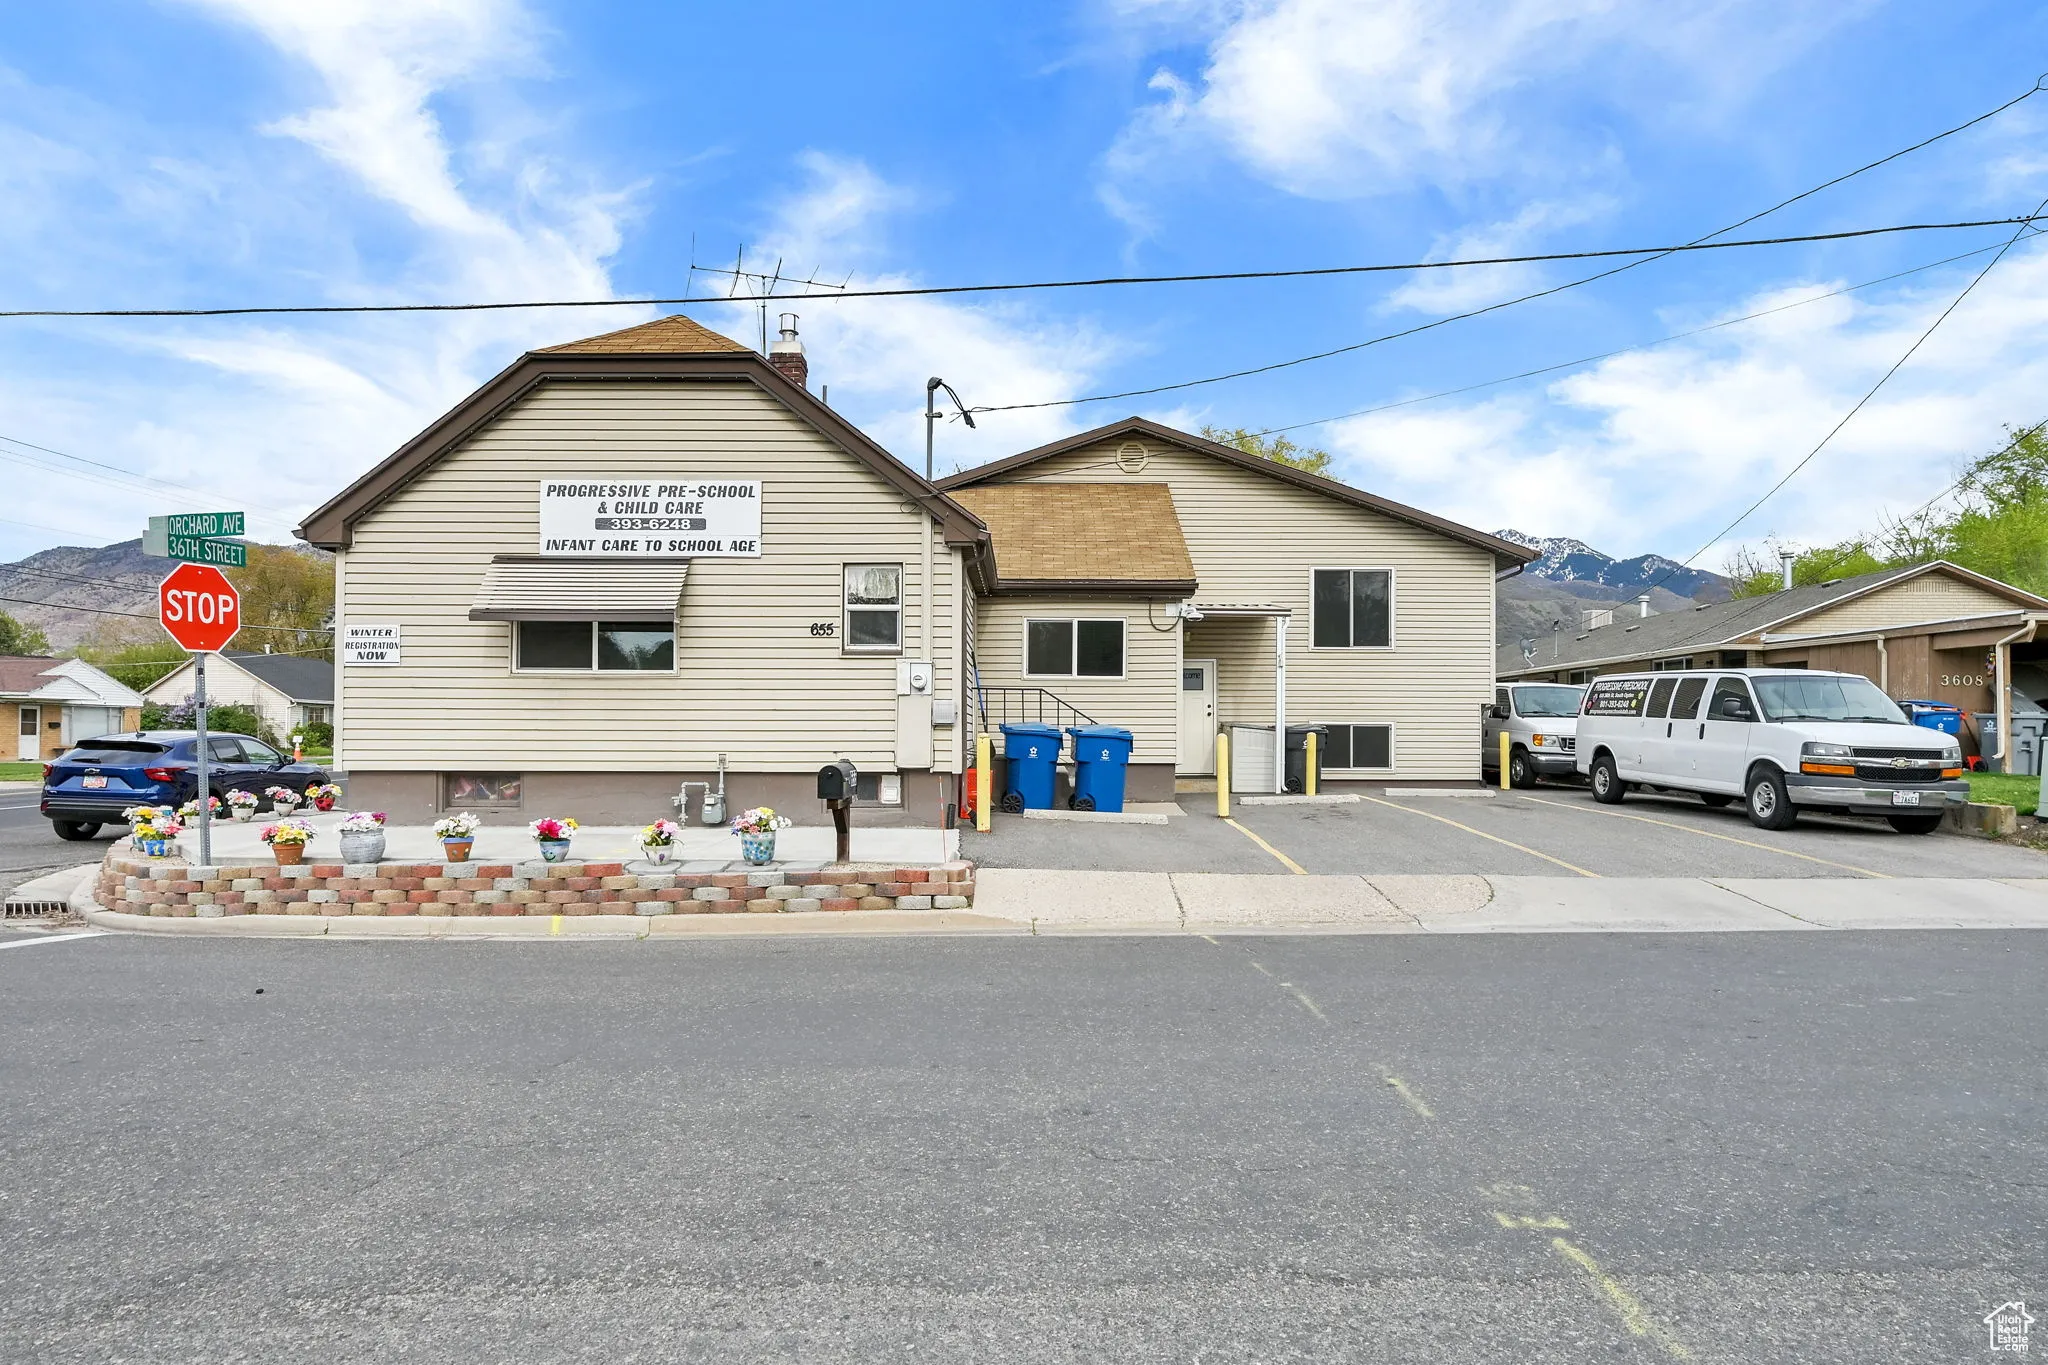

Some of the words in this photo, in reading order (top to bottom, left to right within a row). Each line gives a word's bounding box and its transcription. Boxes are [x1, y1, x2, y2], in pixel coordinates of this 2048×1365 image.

[546, 484, 651, 498] PROGRESSIVE
[657, 485, 756, 499] PRE-SCHOOL
[597, 501, 608, 514] &
[614, 501, 659, 514] CHILD
[664, 501, 704, 515] CARE
[169, 515, 217, 534] ORCHARD
[610, 518, 691, 530] 393-6248
[169, 537, 202, 559] 36TH
[204, 542, 243, 564] STREET
[546, 539, 596, 551] INFANT
[601, 539, 639, 552] CARE
[645, 539, 662, 552] TO
[668, 540, 724, 552] SCHOOL
[729, 540, 757, 552] AGE
[166, 589, 234, 625] STOP
[810, 622, 834, 636] 655
[345, 641, 399, 650] REGISTRATION
[356, 651, 387, 660] NOW
[1594, 682, 1622, 690] PROGRESSIVE
[1621, 681, 1649, 690] PRESCHOOL
[1940, 674, 1984, 687] 3608
